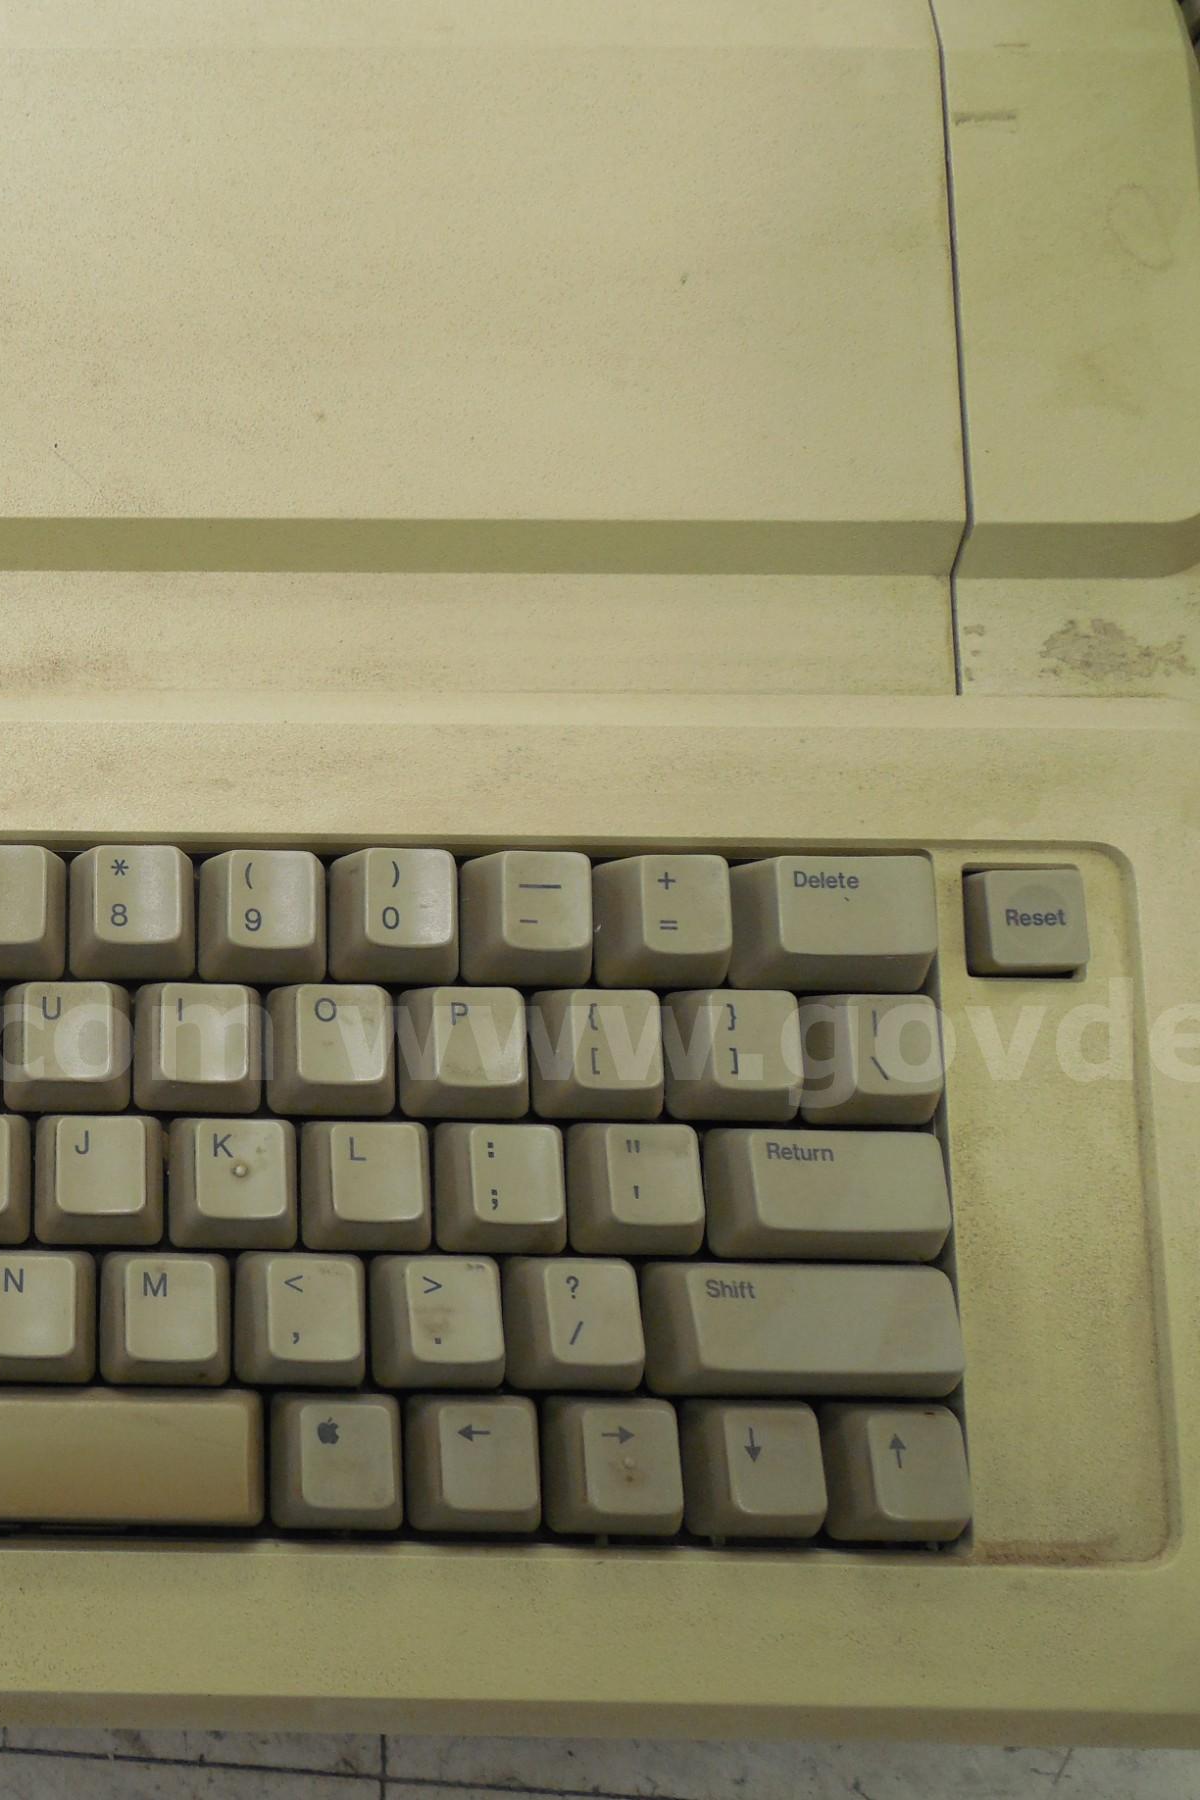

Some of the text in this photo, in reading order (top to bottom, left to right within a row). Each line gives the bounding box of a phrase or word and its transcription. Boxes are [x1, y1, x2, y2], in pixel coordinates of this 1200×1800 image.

[244, 862, 253, 890] (
[391, 860, 400, 888] )
[657, 871, 677, 891] +
[793, 870, 860, 890] Delete
[110, 903, 129, 927] 8
[244, 908, 262, 932] 9
[382, 906, 400, 930] 0
[659, 919, 679, 931] =
[1005, 908, 1067, 927] Reset
[41, 995, 62, 1021] U
[177, 997, 183, 1022] I
[314, 997, 337, 1023] O
[450, 1001, 468, 1026] P
[74, 1130, 90, 1155] J
[213, 1133, 234, 1158] K
[348, 1136, 367, 1162] L
[765, 1141, 835, 1162] Return
[3, 1267, 24, 1294] N
[143, 1271, 168, 1298] M
[283, 1274, 304, 1293] <
[422, 1276, 443, 1294] >
[565, 1275, 580, 1300] ?
[705, 1279, 756, 1300] Shift
[569, 1320, 584, 1346] /
